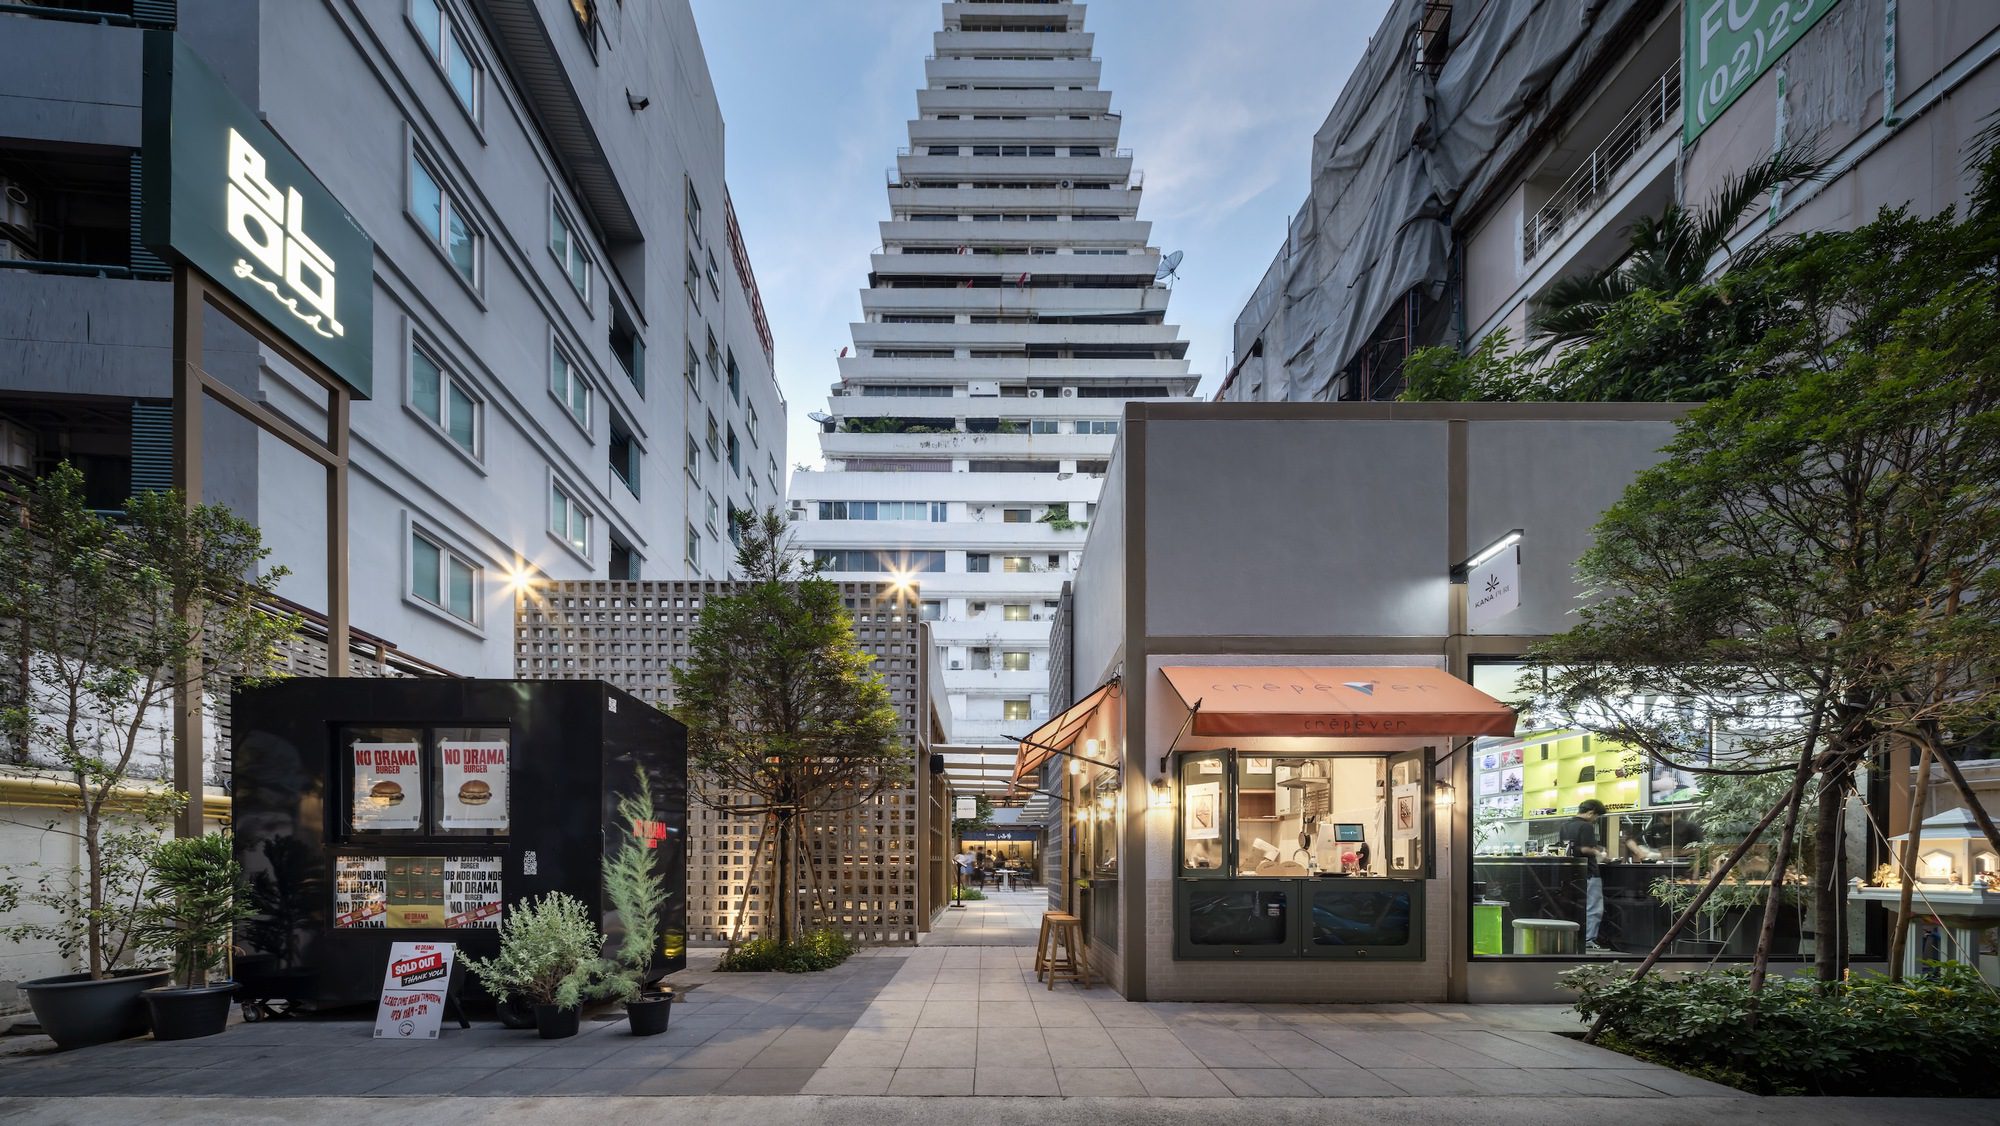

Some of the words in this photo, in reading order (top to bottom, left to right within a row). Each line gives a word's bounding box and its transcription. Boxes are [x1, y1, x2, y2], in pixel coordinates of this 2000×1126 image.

[1475, 594, 1494, 608] KANA
[355, 750, 372, 766] NO
[374, 750, 418, 766] DRAMA
[444, 749, 461, 765] NO
[463, 749, 506, 765] DRAMA
[375, 765, 401, 774] BURGER
[463, 765, 488, 773] BURGER
[450, 882, 463, 894] NO
[464, 882, 499, 894] DRAMA
[336, 902, 350, 913] NO
[351, 901, 380, 913] DRA
[449, 901, 463, 913] NO
[464, 902, 495, 913] DRA
[395, 961, 417, 975] SOLD
[418, 957, 435, 969] OUT
[404, 973, 427, 984] THANK
